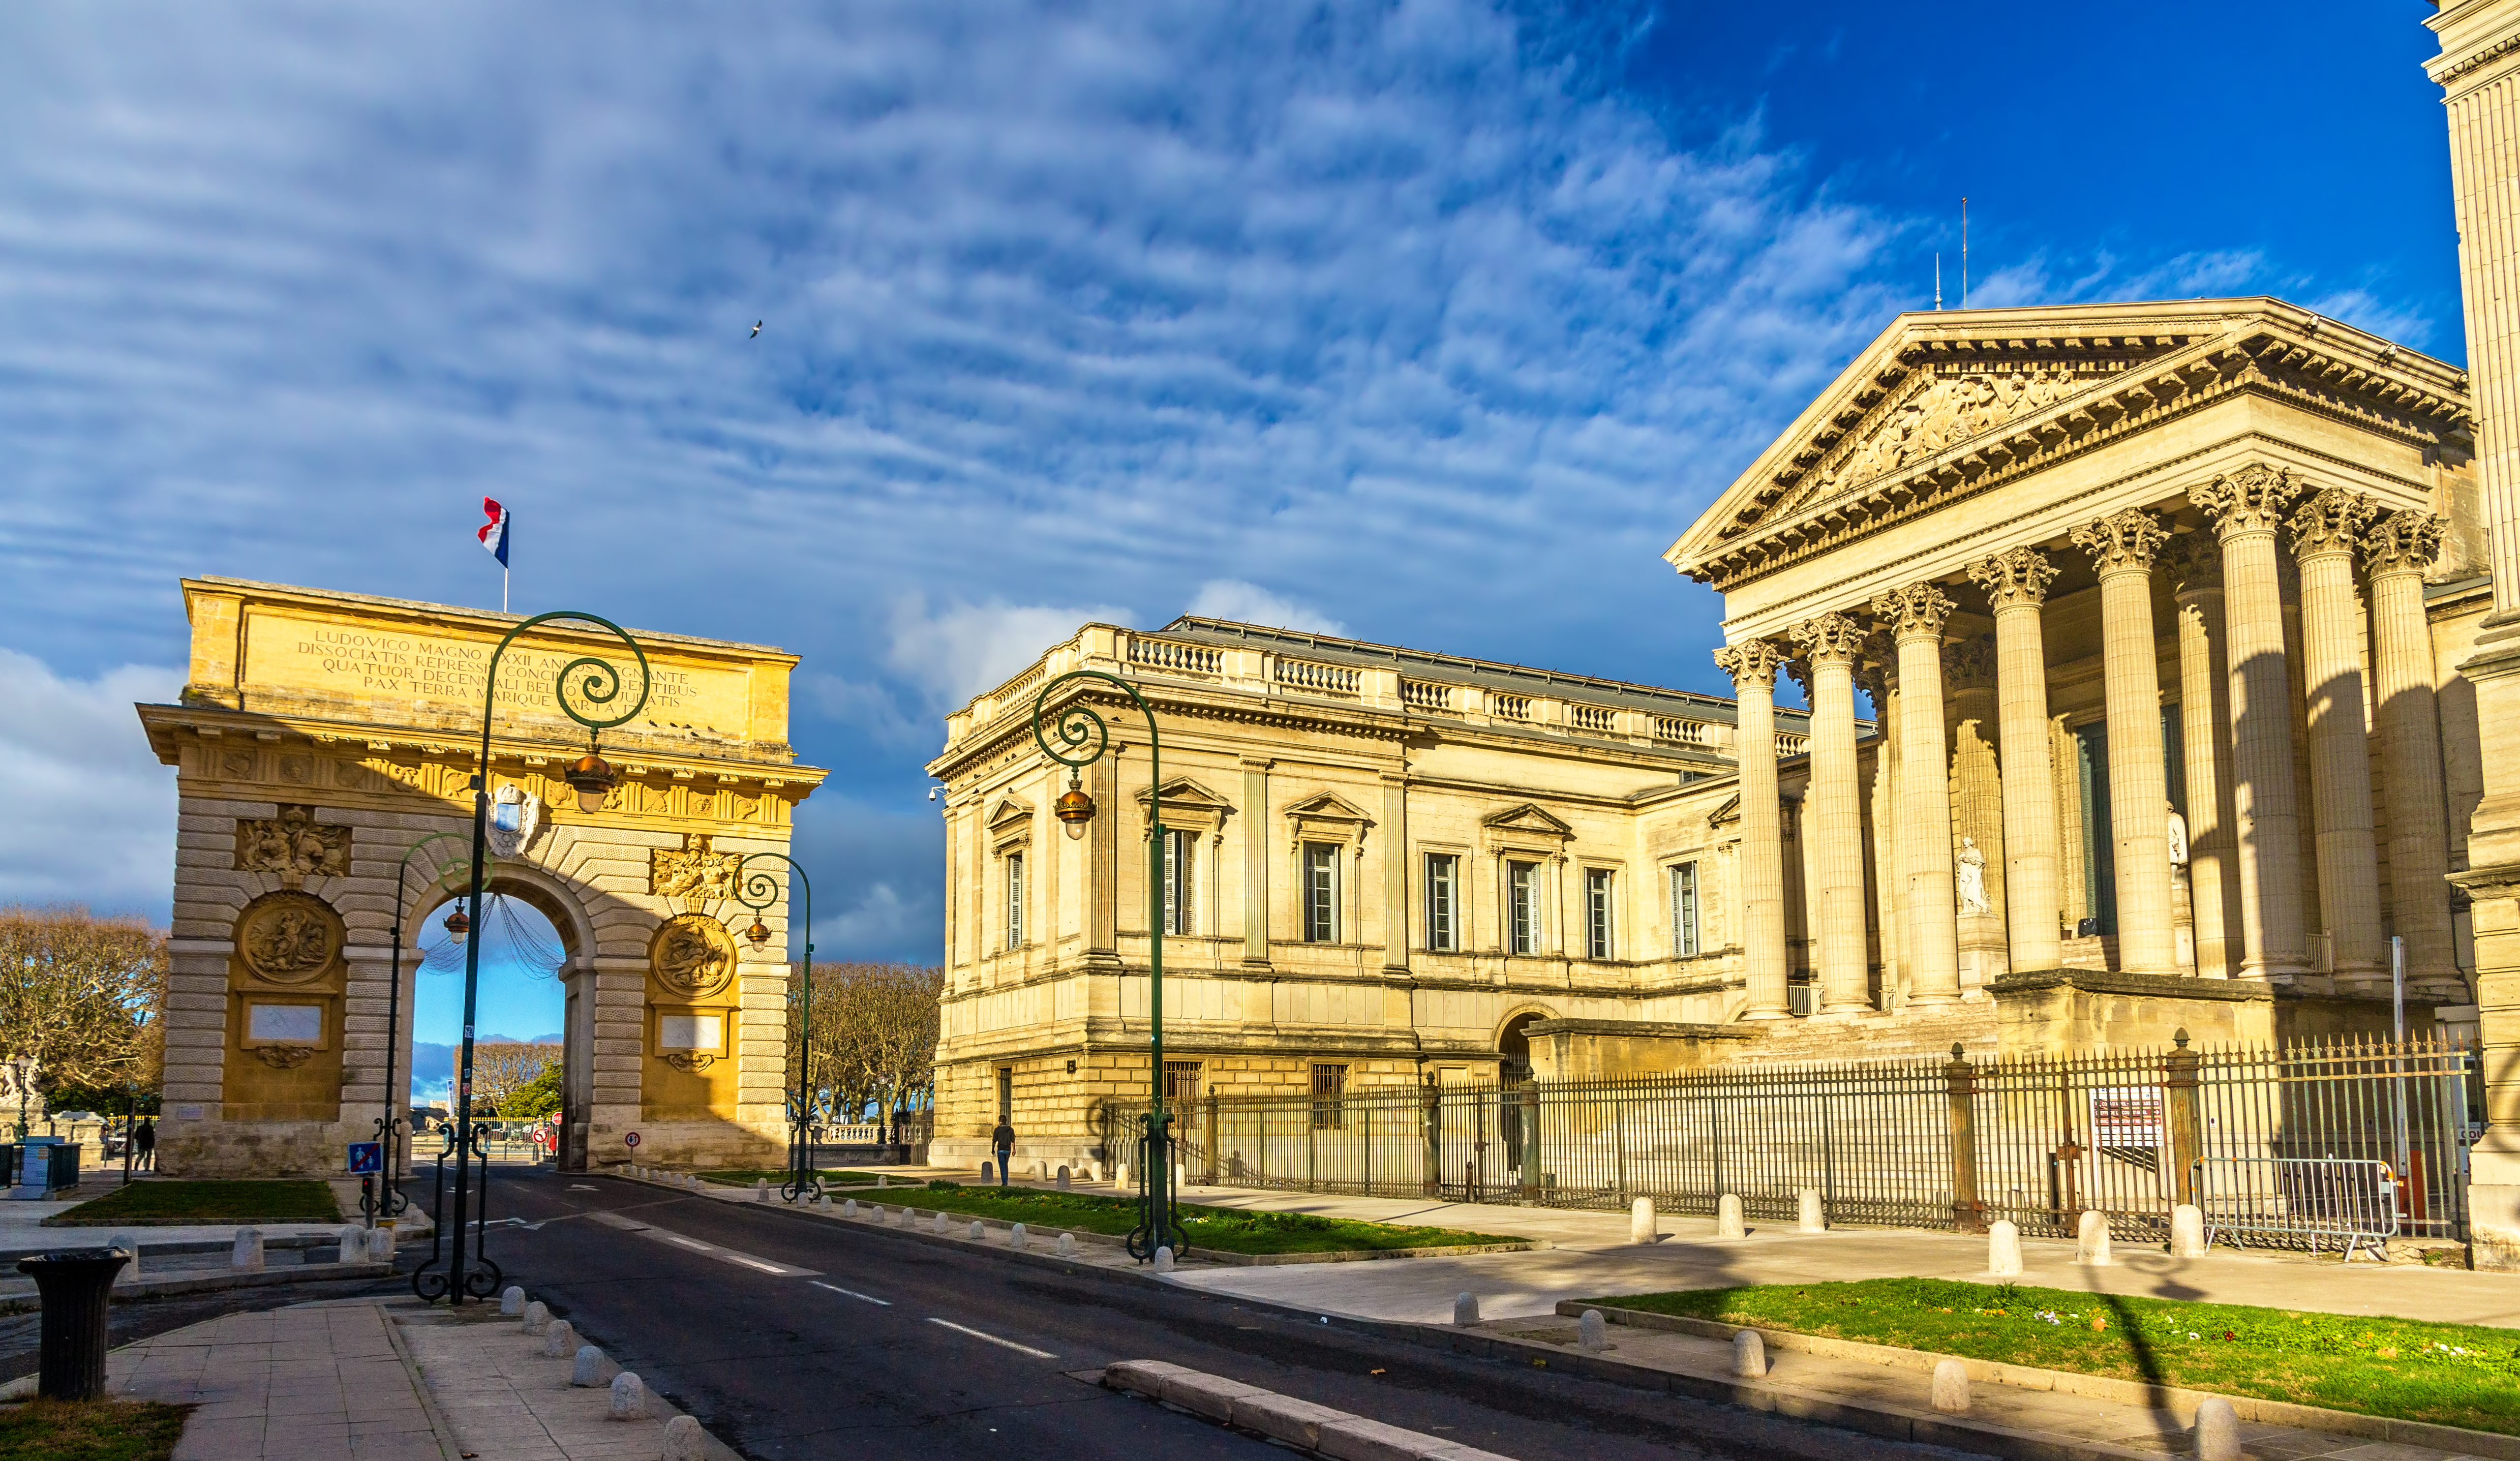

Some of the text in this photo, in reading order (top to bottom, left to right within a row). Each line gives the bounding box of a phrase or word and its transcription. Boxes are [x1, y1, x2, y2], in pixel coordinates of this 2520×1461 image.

[315, 630, 410, 652] LUDOVICO
[419, 643, 482, 660] MAGNO
[298, 642, 407, 664] DISSOCIATIS
[416, 655, 495, 675] REPRESSI
[505, 666, 608, 687] CONCILIAS
[323, 658, 414, 679] QUATUOR
[424, 669, 519, 690] DECENNALI
[527, 681, 576, 696] BELO
[364, 676, 399, 690] PAX
[409, 681, 468, 697] TERRA
[476, 688, 551, 707] MARIQUE
[560, 698, 615, 714] ARA
